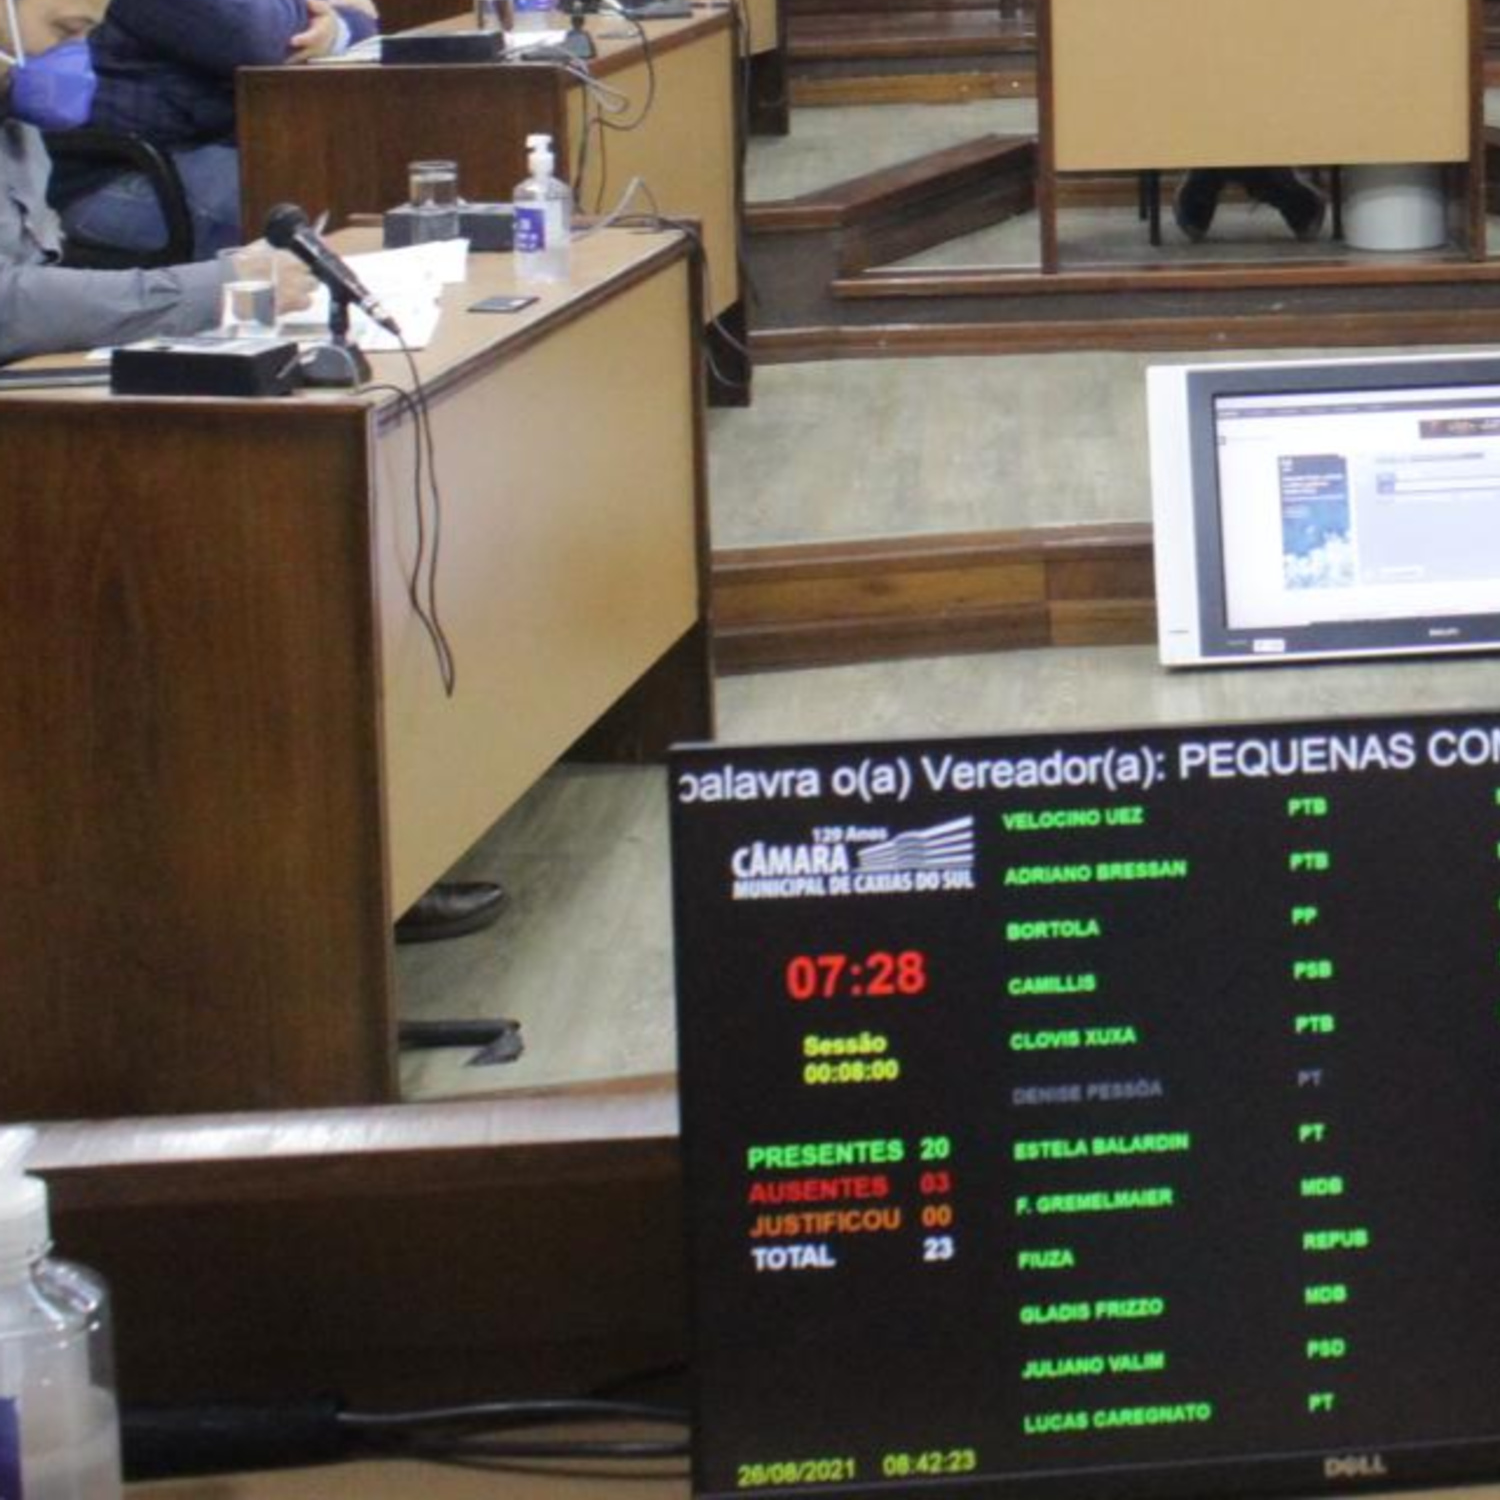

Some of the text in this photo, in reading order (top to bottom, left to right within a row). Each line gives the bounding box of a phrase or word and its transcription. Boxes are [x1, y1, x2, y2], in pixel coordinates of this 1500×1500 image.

[832, 758, 911, 801] o(a)
[922, 747, 1165, 791] Vereador(a):
[1178, 732, 1416, 779] PEQUENAS
[1288, 797, 1327, 815] PTB
[1003, 806, 1143, 830] VELOCINO UEZ
[731, 840, 849, 877] CÂMARA
[1290, 852, 1328, 869] PTB
[1005, 861, 1187, 884] ADRIANO BRESSAN
[732, 867, 975, 900] MUNICIPAL DE CAXIAS DO SUL
[1292, 907, 1317, 923] PP
[1007, 920, 1099, 940] BORTOLA
[787, 951, 925, 999] 07:28
[1294, 960, 1332, 978] PSB
[1008, 974, 1096, 995] CAMILLIS
[1296, 1015, 1334, 1032] PTB
[803, 1032, 888, 1057] Sessão
[1010, 1027, 1136, 1050] CLOVIS XUXA
[1298, 1069, 1321, 1085] PT
[1013, 1084, 1081, 1104] DENISE
[1299, 1124, 1324, 1141] PT
[748, 1137, 950, 1169] PRESENTES 20
[1014, 1133, 1189, 1160] ESTELA BALARDIN
[750, 1172, 950, 1202] AUSENTES 03
[1301, 1177, 1343, 1195] MDB
[1017, 1197, 1030, 1213] F.
[750, 1205, 952, 1237] JUSTIFICOU 00
[1303, 1229, 1368, 1249] REPUB
[753, 1236, 953, 1270] TOTAL 23
[1019, 1250, 1074, 1268] FIUZA
[1305, 1285, 1347, 1303] MDB
[1020, 1298, 1163, 1324] GLADIS FRIZZO
[1307, 1339, 1345, 1357] PSD
[1023, 1352, 1164, 1378] JULIANO VALIM
[1309, 1393, 1333, 1410] PT
[1024, 1403, 1211, 1433] LUCAS CAREGNATO
[1325, 1455, 1385, 1477] DELL
